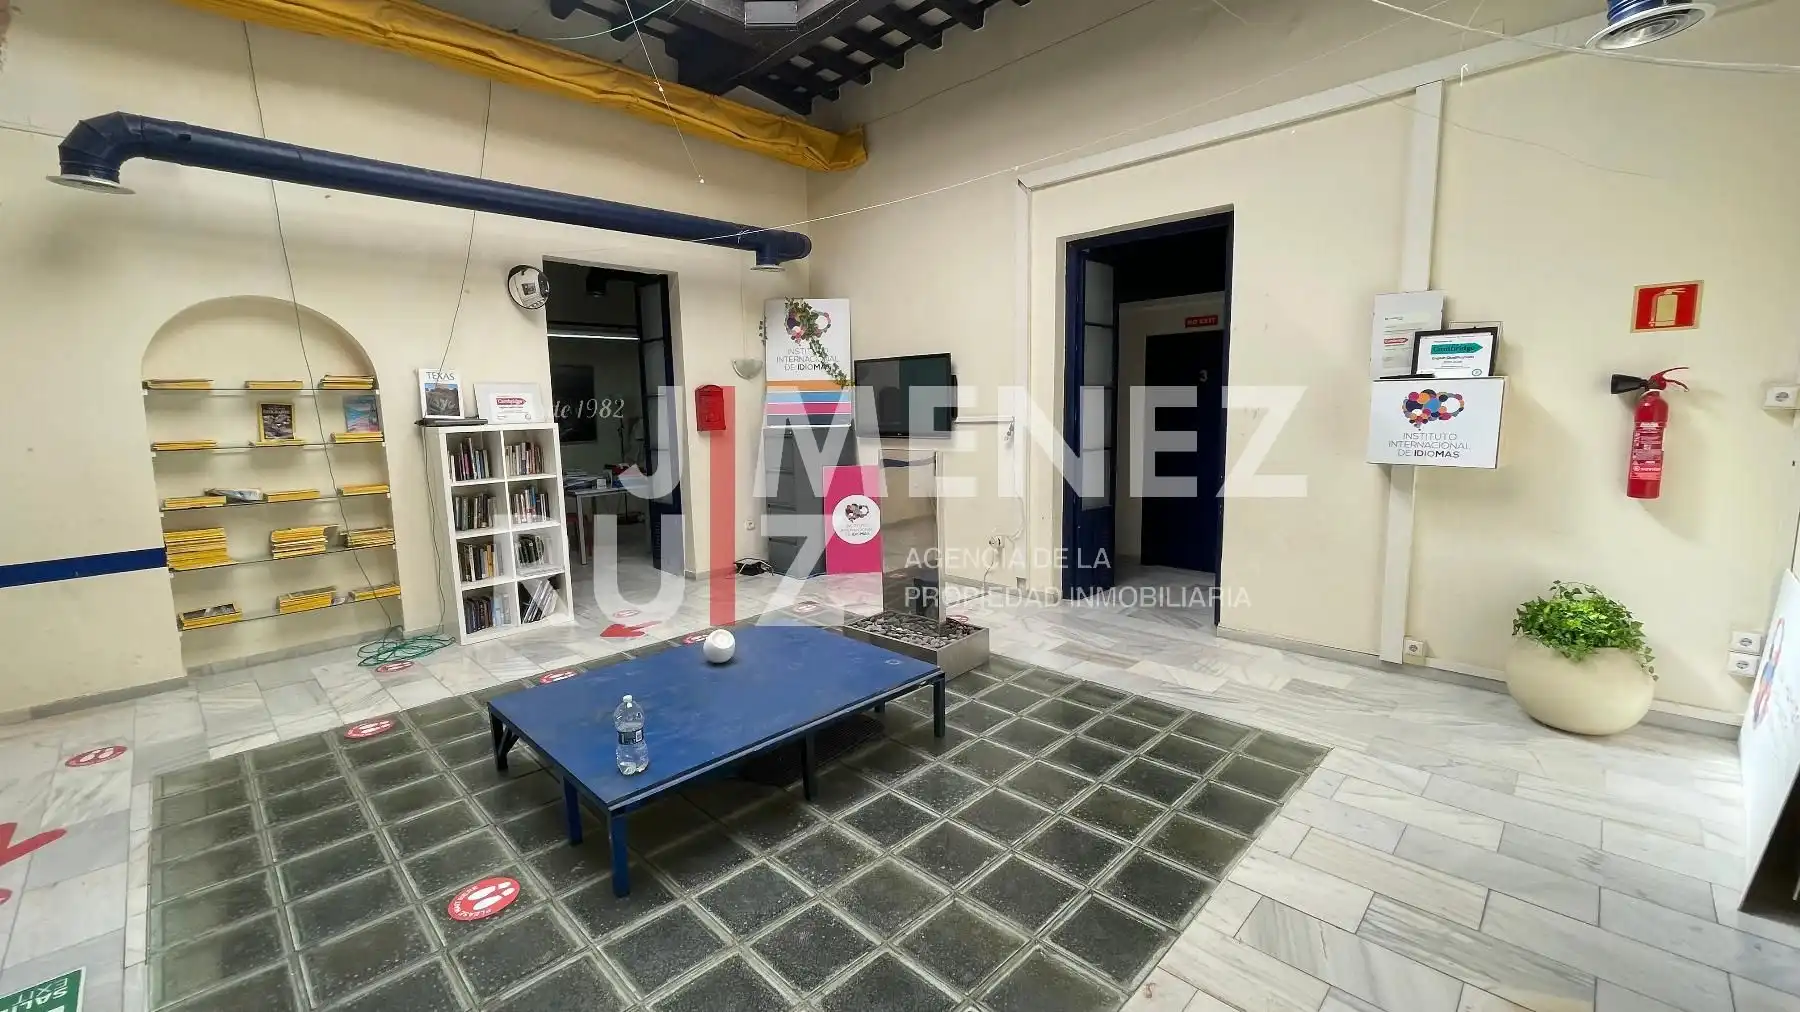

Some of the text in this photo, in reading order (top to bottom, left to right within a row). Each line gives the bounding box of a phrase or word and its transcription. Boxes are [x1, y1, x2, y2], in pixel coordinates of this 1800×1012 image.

[784, 363, 832, 371] DE IDIOMA
[425, 371, 455, 381] TEXAS
[1199, 369, 1208, 382] 3
[577, 398, 625, 419] 1982
[1403, 432, 1457, 441] INSTITUTO
[1388, 440, 1469, 450] INTERNACIONAL
[1397, 448, 1460, 458] DE IDIOMAS
[12, 977, 68, 1007] EXIT
